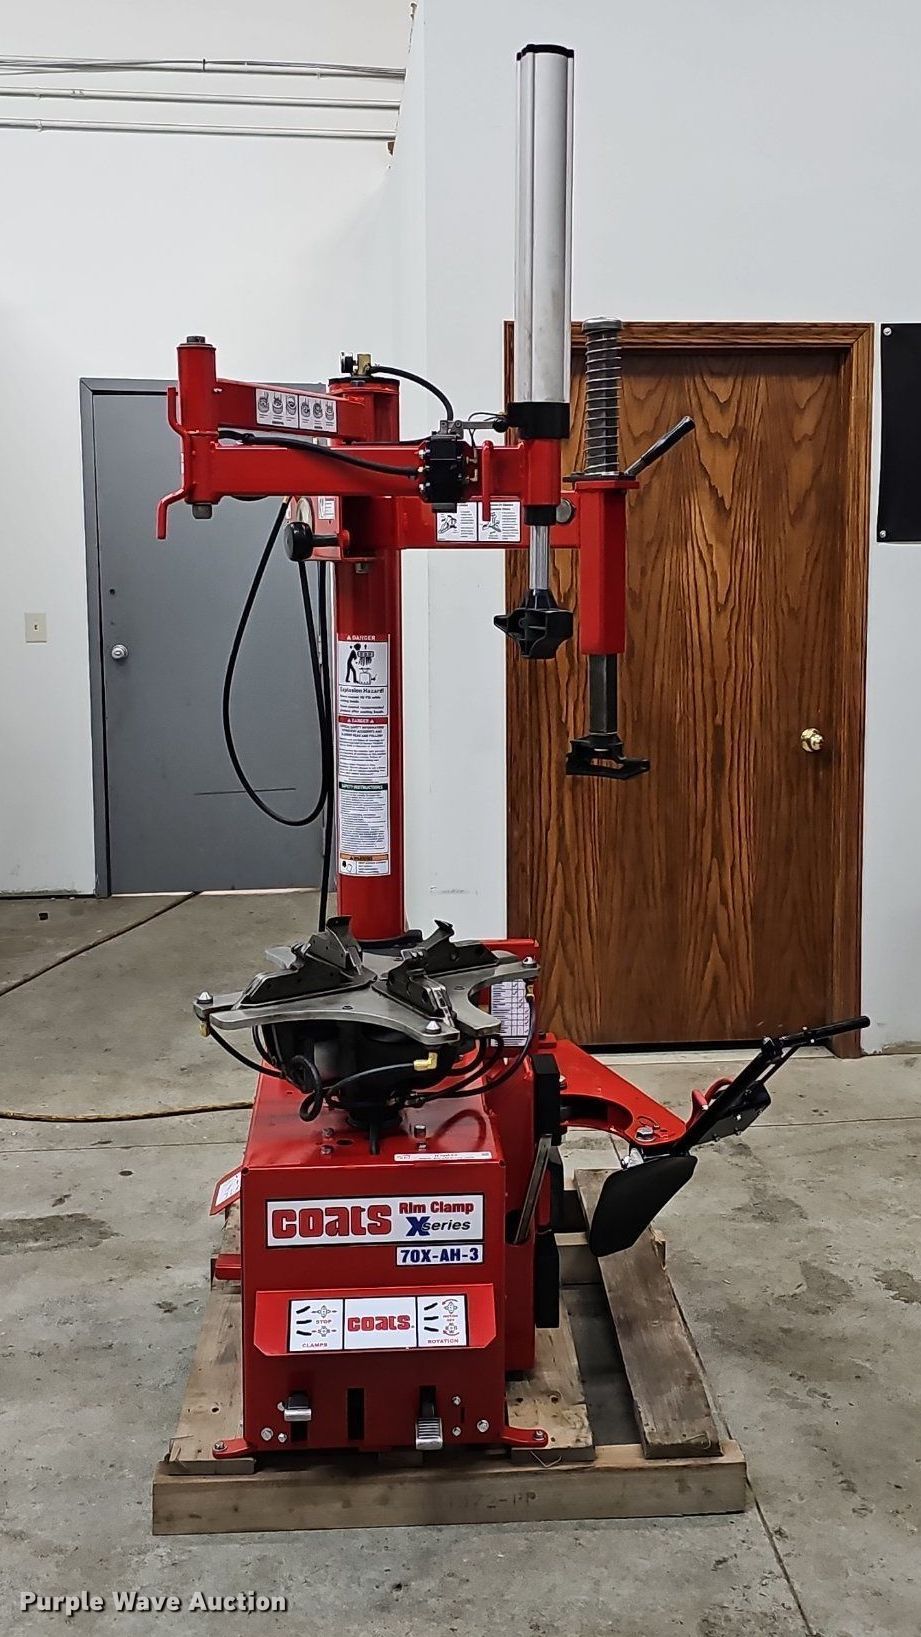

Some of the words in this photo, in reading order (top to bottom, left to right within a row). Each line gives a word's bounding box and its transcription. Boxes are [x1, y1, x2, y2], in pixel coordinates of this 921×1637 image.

[272, 1204, 392, 1239] coats
[399, 1202, 426, 1214] Rim
[430, 1201, 474, 1215] Clamp
[400, 1247, 479, 1263] 70X-AH-3
